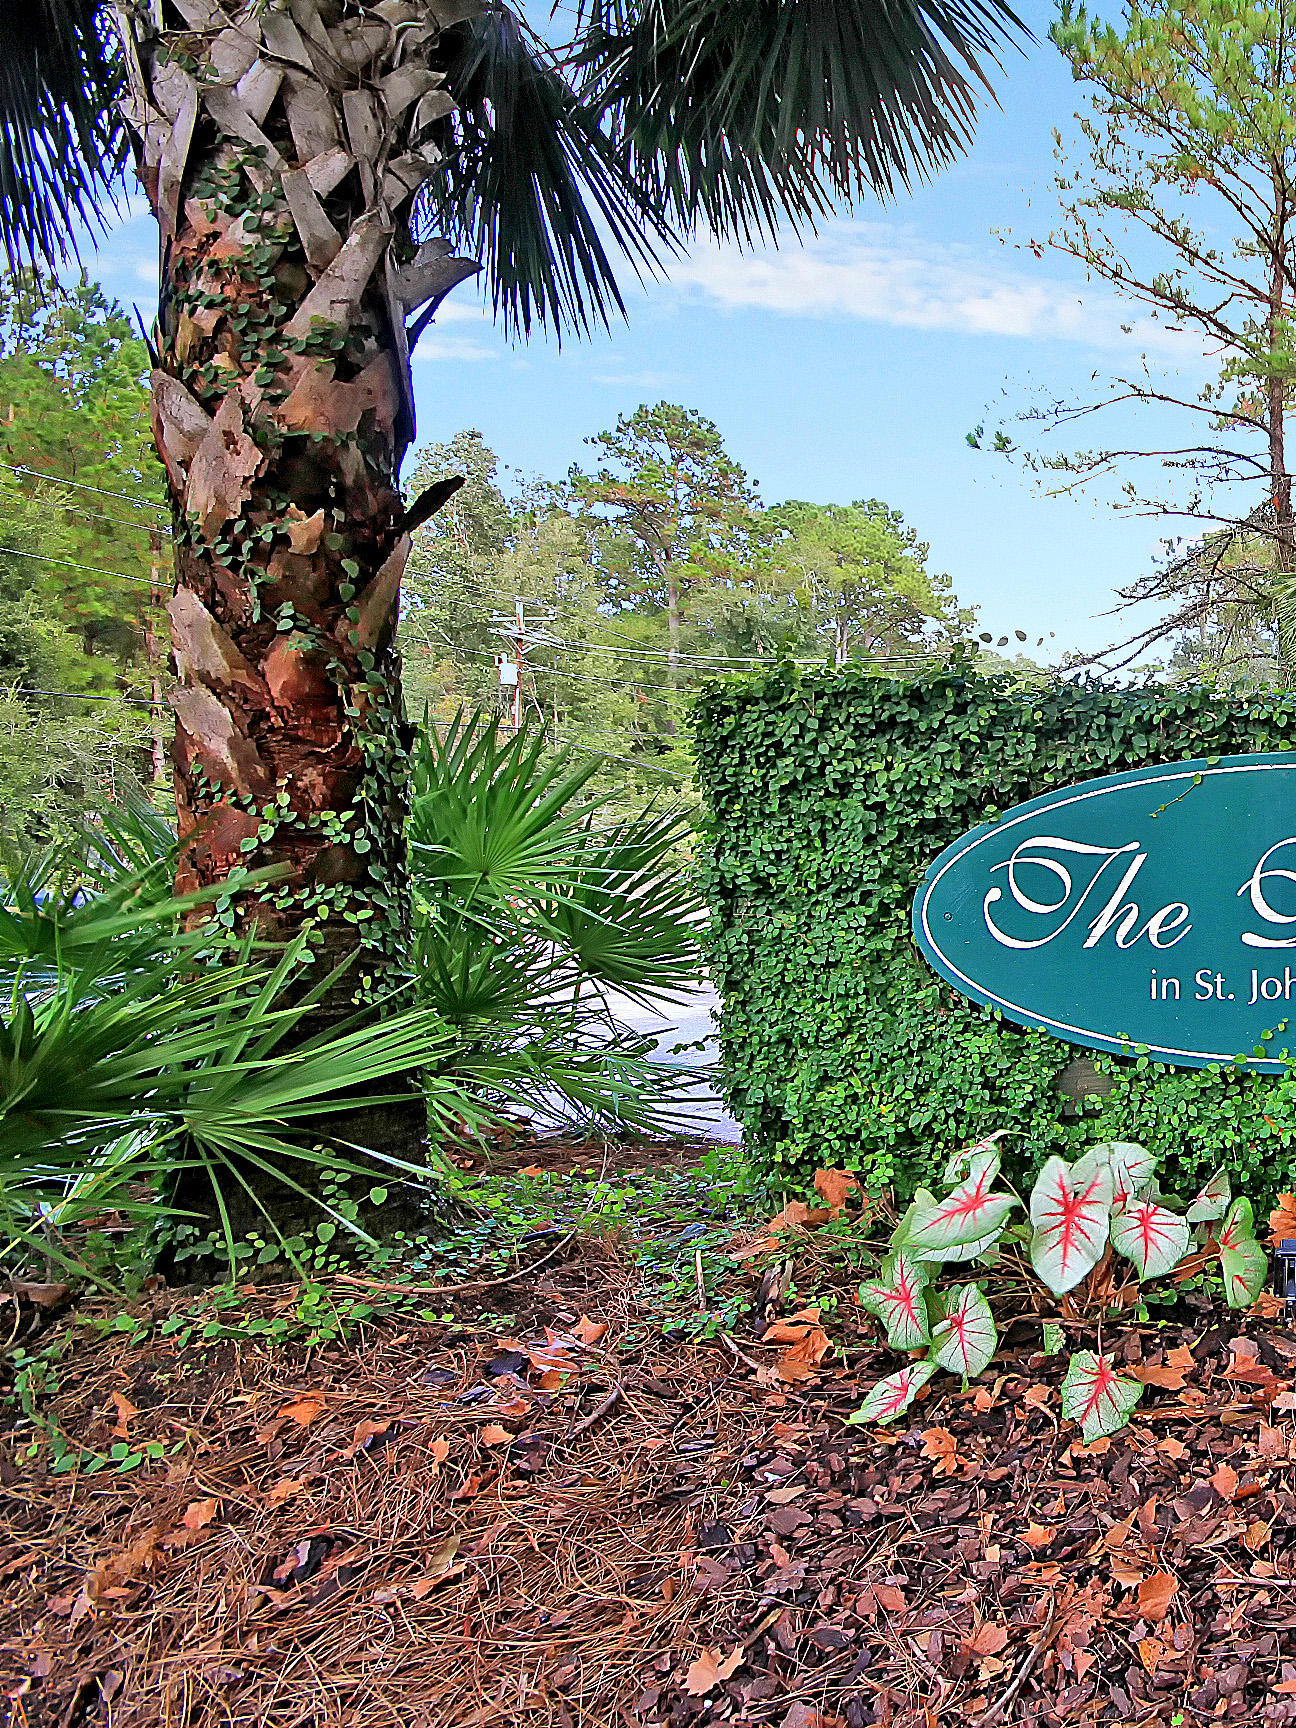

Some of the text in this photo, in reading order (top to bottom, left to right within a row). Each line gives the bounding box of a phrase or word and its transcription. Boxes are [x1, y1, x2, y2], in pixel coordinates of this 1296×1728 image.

[981, 835, 1193, 950] The
[1149, 968, 1181, 1001] in
[1193, 969, 1236, 1001] St.
